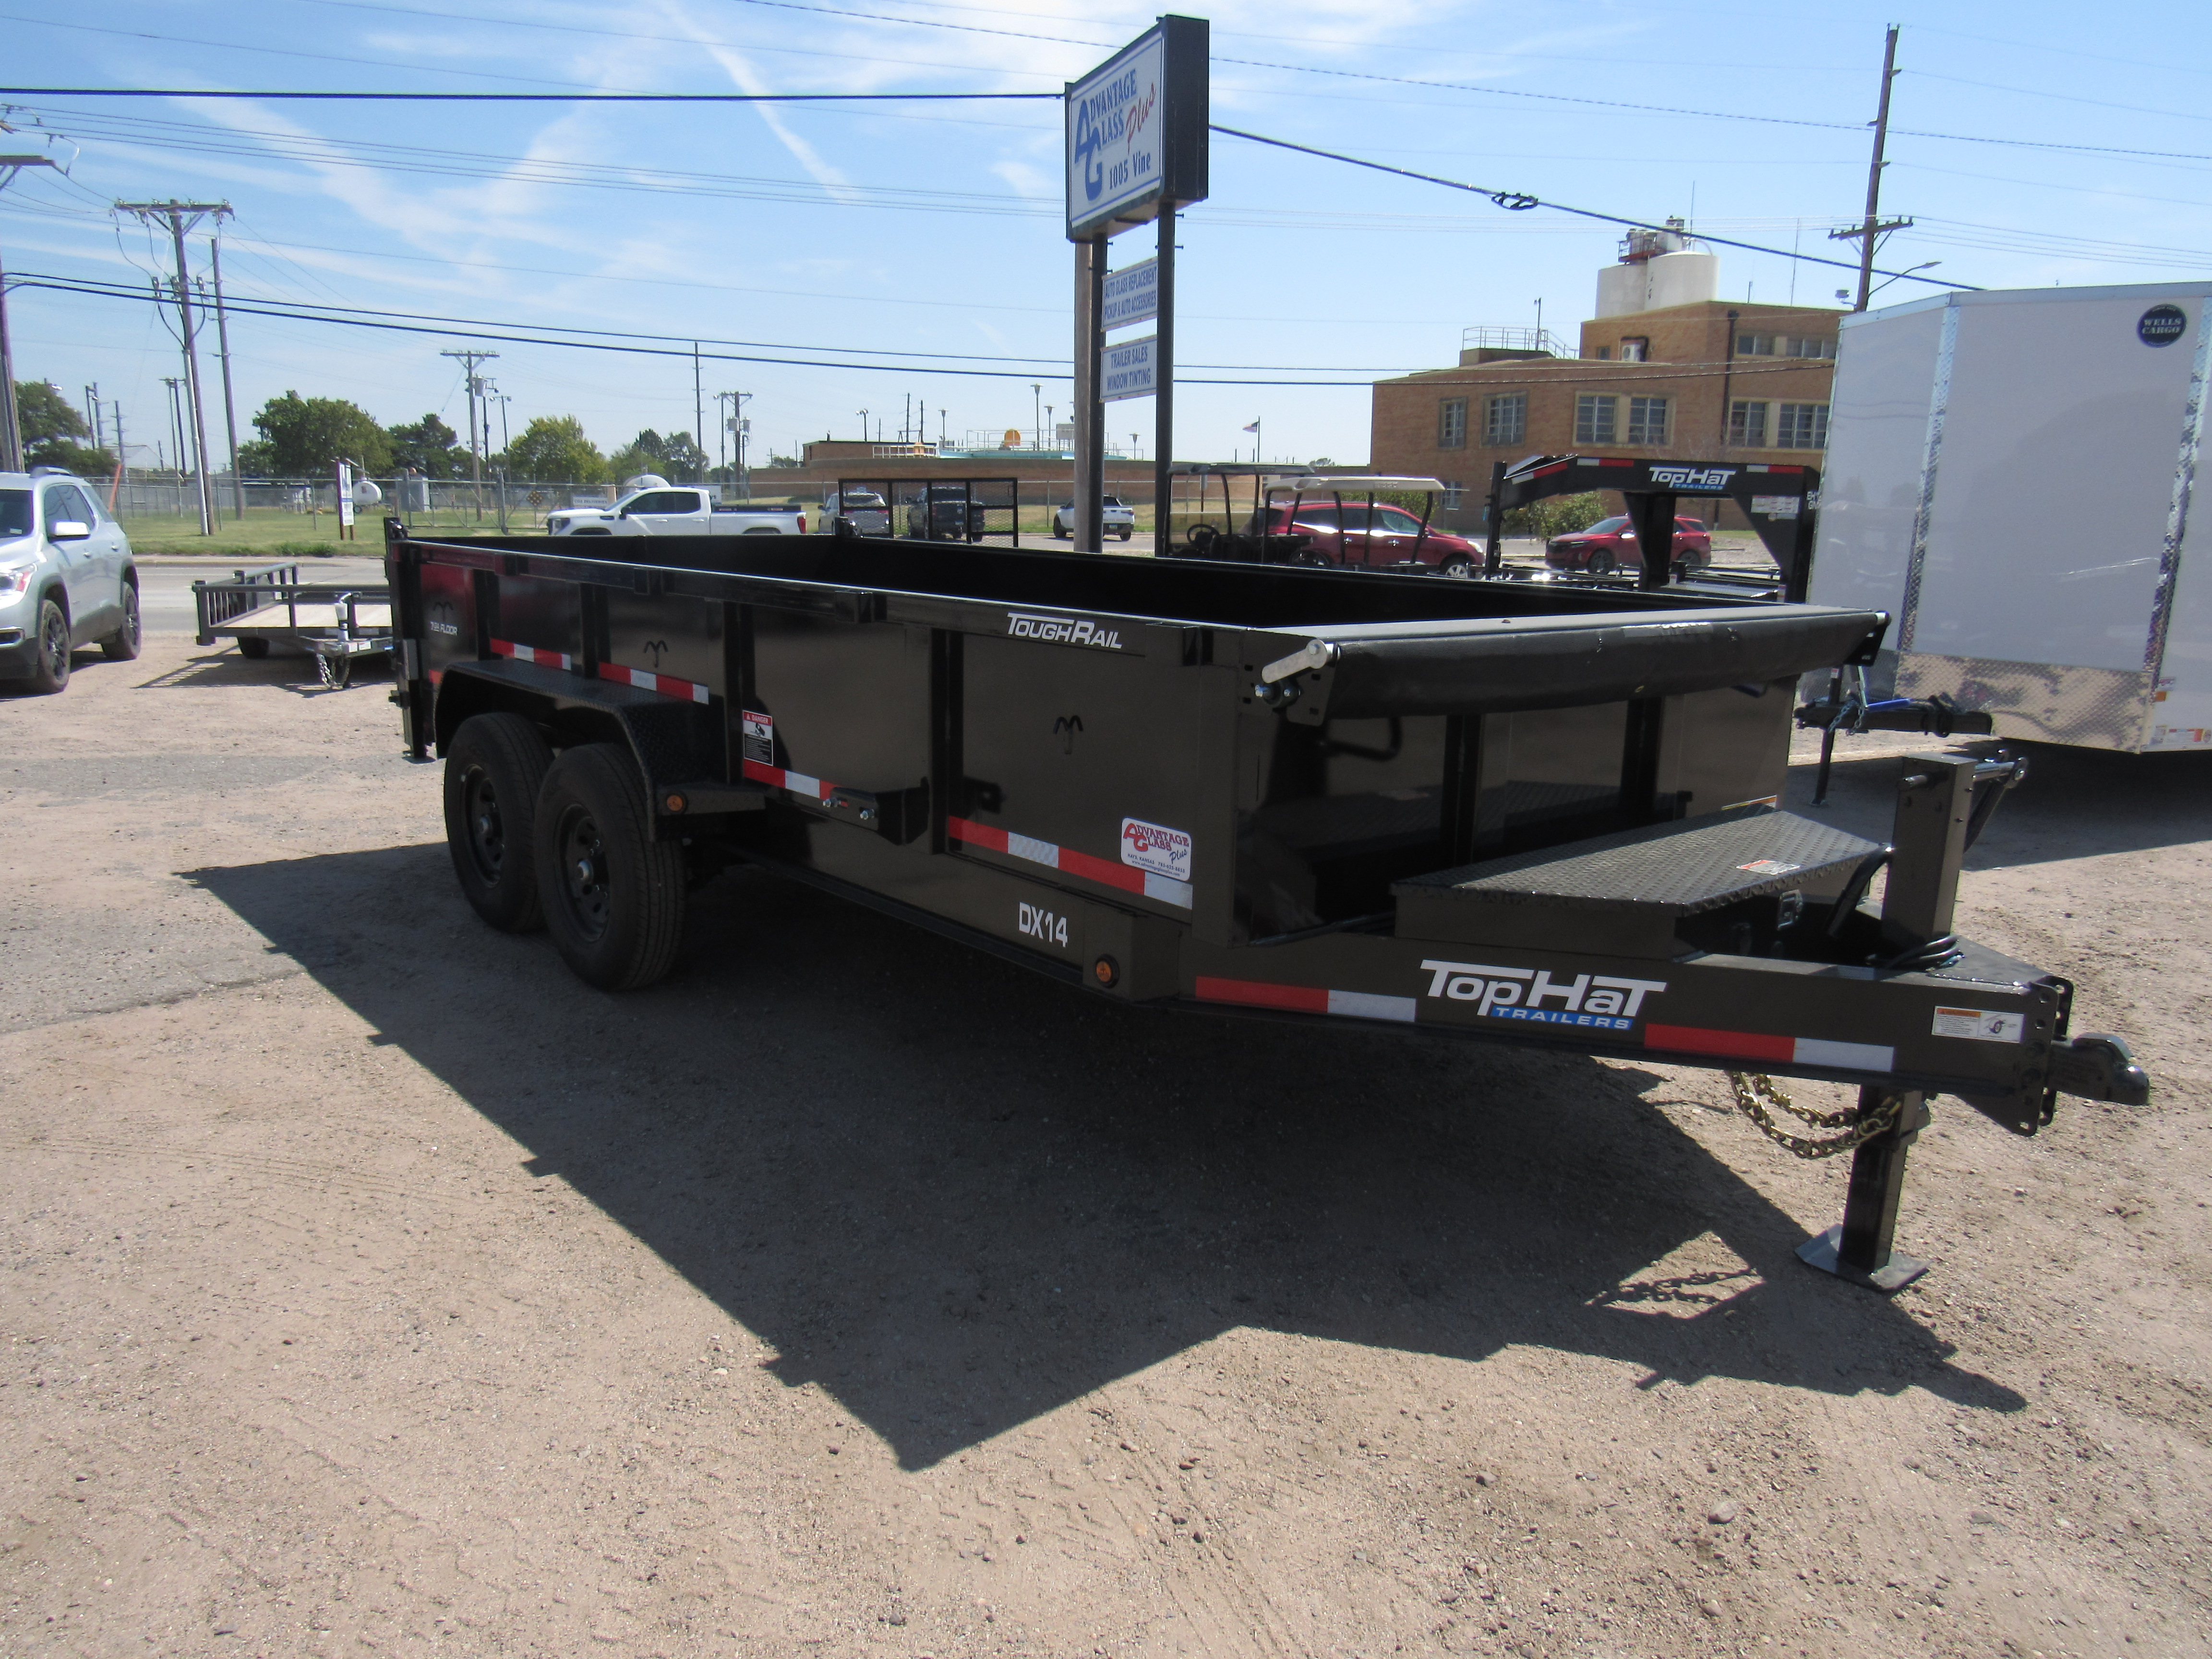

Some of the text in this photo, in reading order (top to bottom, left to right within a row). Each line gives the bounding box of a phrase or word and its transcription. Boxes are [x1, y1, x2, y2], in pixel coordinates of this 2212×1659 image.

[1074, 69, 1137, 164] ADVANTAGE
[1085, 82, 1156, 202] GLASS Plus
[1109, 151, 1151, 190] 1005 Vine
[1105, 266, 1157, 299] AUTO GLASS REPLACEMENT
[1105, 301, 1117, 320] PICKUP
[1122, 298, 1130, 315] AUTO
[1131, 290, 1156, 313] ACCESSORIES
[2141, 326, 2180, 335] CARGO
[2144, 317, 2182, 326] WELLS
[1111, 346, 1148, 369] TRAILER SALES
[1107, 368, 1151, 391] WINDOW TINTING
[440, 624, 458, 636] FLOOR
[752, 714, 769, 723] DANGER
[1123, 823, 1190, 847] ADVANTAGE
[1133, 834, 1172, 852] GLASS
[1138, 856, 1154, 865] KANSAS
[1169, 848, 1188, 864] Plus
[1019, 902, 1068, 948] DX14
[1496, 1007, 1630, 1030] TRAILERS
